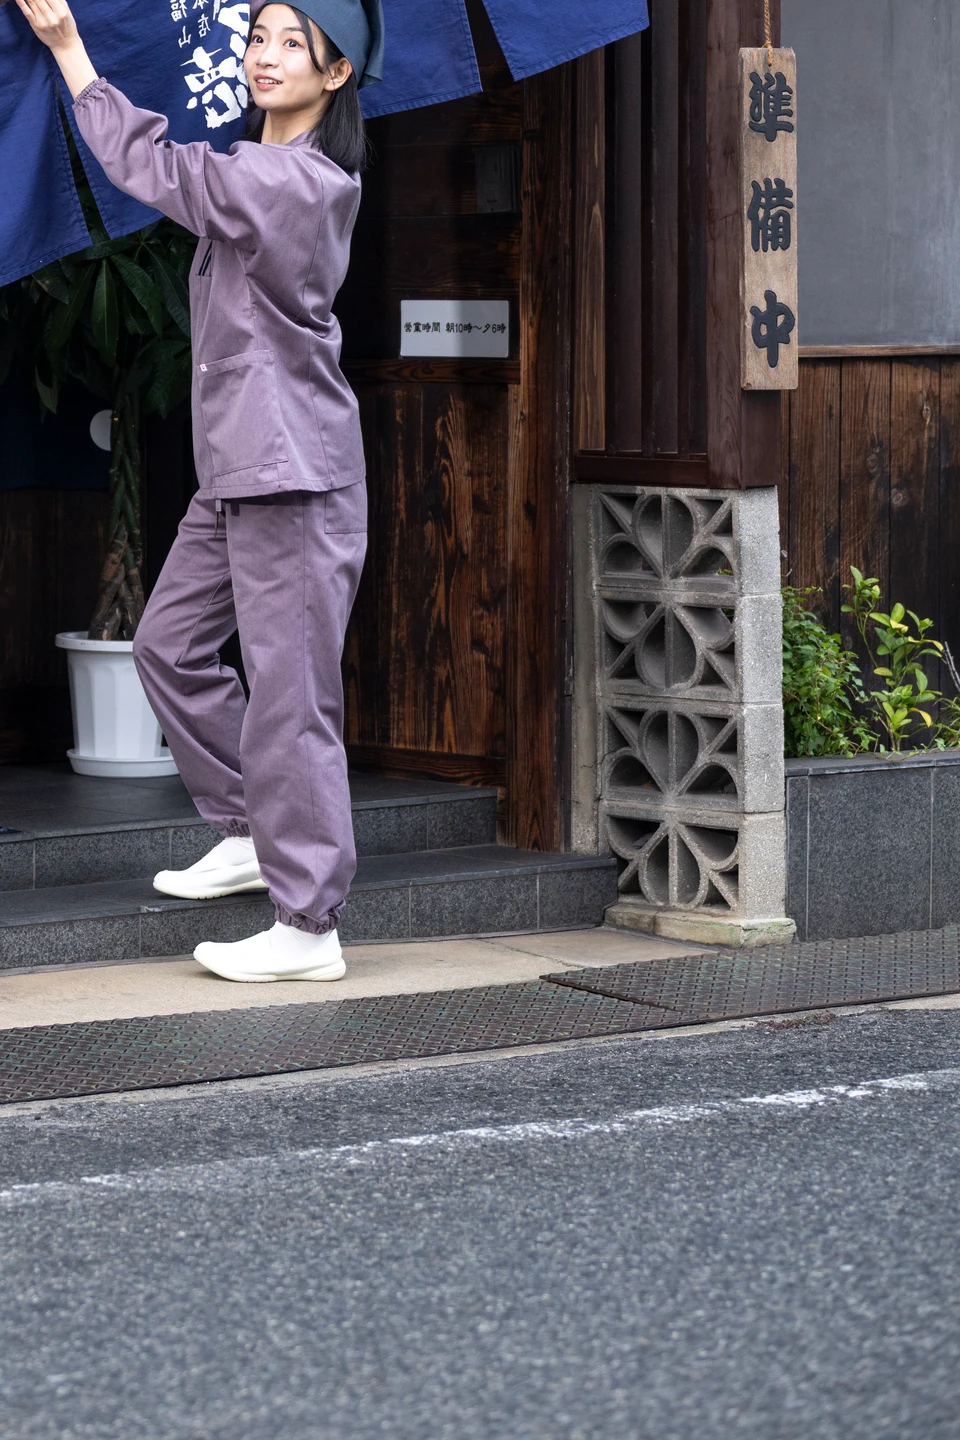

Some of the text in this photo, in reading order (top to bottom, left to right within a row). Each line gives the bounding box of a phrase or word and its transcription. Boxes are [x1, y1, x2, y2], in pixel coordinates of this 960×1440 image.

[748, 71, 795, 368] 準備中
[403, 322, 441, 333] 営業時間
